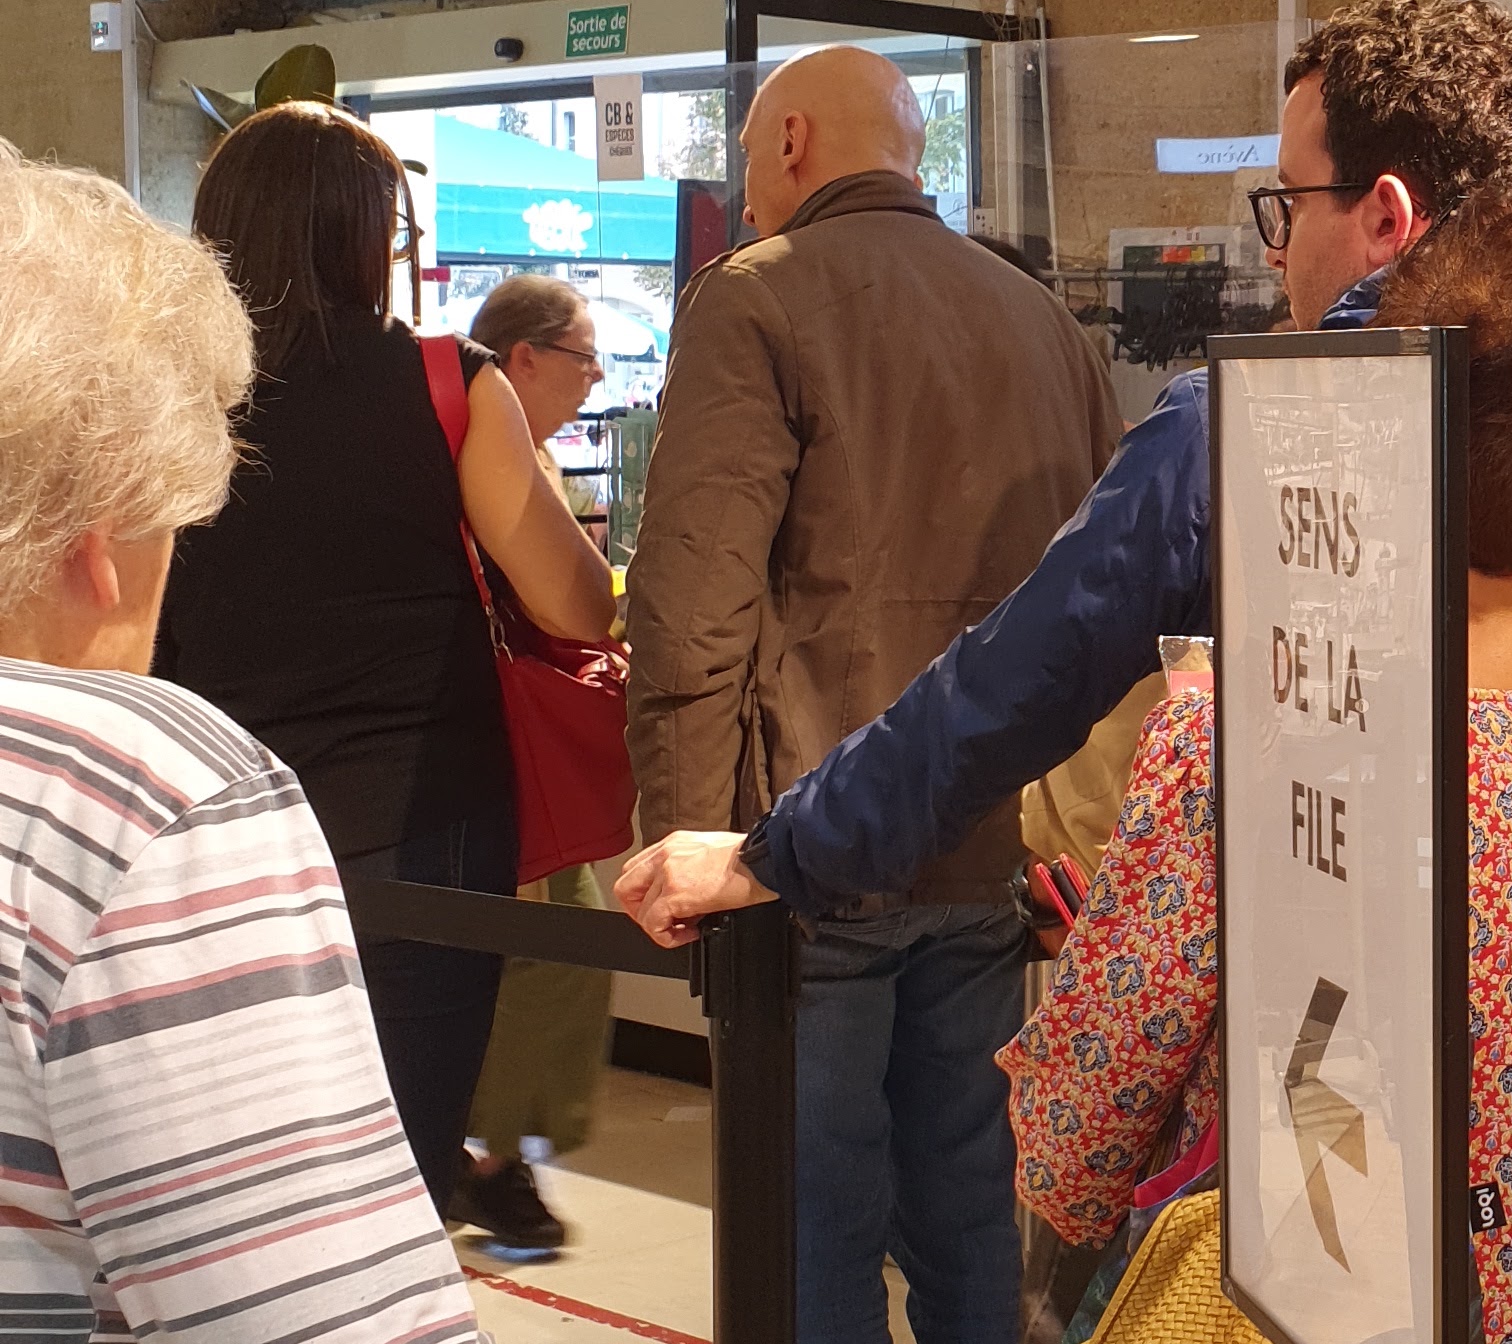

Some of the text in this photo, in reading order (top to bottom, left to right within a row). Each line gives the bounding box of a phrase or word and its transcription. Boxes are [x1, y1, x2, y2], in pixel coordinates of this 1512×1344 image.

[569, 11, 627, 35] Sortie de
[572, 33, 621, 53] secours
[605, 100, 634, 127] CB &
[1278, 483, 1361, 579] SENS
[1272, 625, 1367, 733] DE LA
[1291, 780, 1348, 884] FILE
